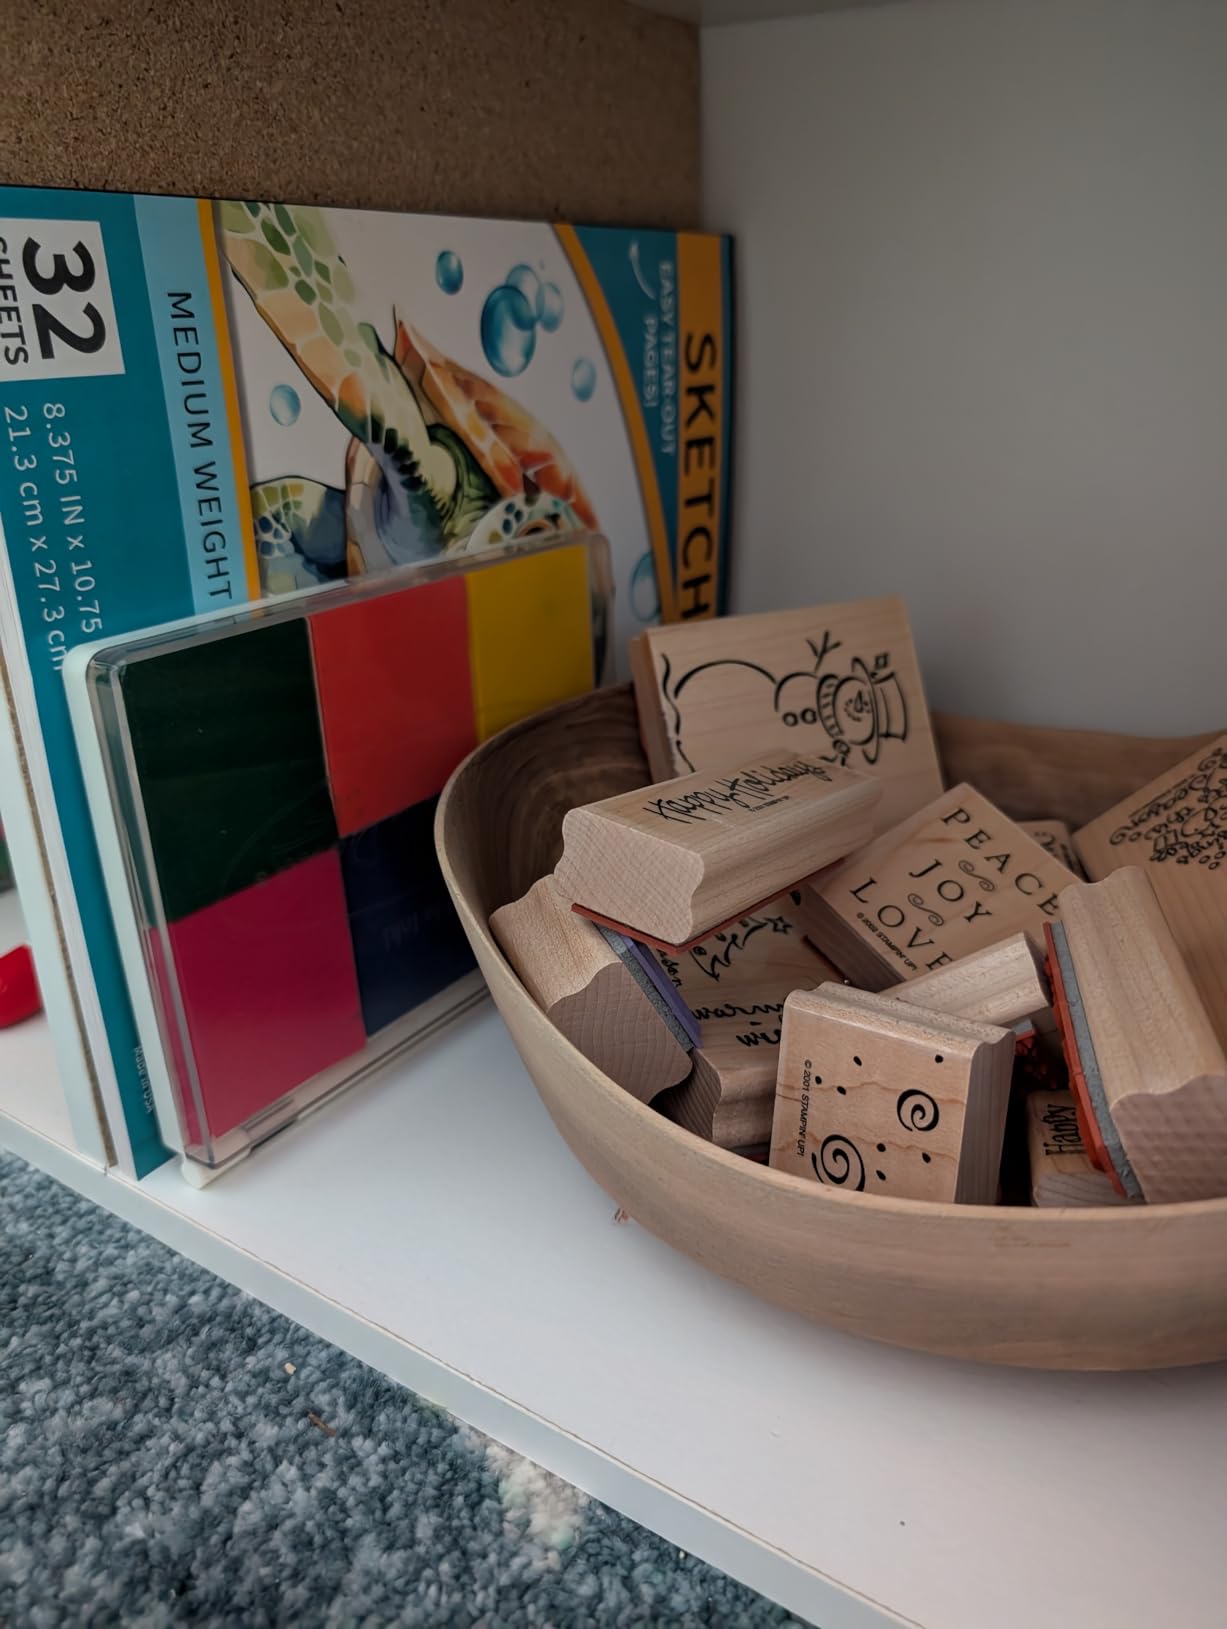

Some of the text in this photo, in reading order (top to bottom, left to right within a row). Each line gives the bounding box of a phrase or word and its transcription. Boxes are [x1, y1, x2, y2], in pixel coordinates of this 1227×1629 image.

[22, 236, 107, 360] 32
[658, 261, 675, 327] EASY
[642, 314, 659, 408] PAGES!
[4, 405, 38, 471] 21.3
[167, 292, 233, 601] MEDIUM WEIGHT
[18, 482, 44, 527] cm
[681, 333, 718, 621] SKETCH
[29, 535, 49, 552] x
[43, 402, 103, 634] 8.375 IN x 10.75
[34, 559, 66, 622] 27.3
[643, 787, 751, 824] Happy
[716, 761, 833, 800] Holidays
[908, 858, 993, 925] JOY
[940, 807, 1060, 916] PEACE
[849, 877, 956, 971] LOVE
[801, 1069, 811, 1092] 2001
[796, 1139, 806, 1157] UP!
